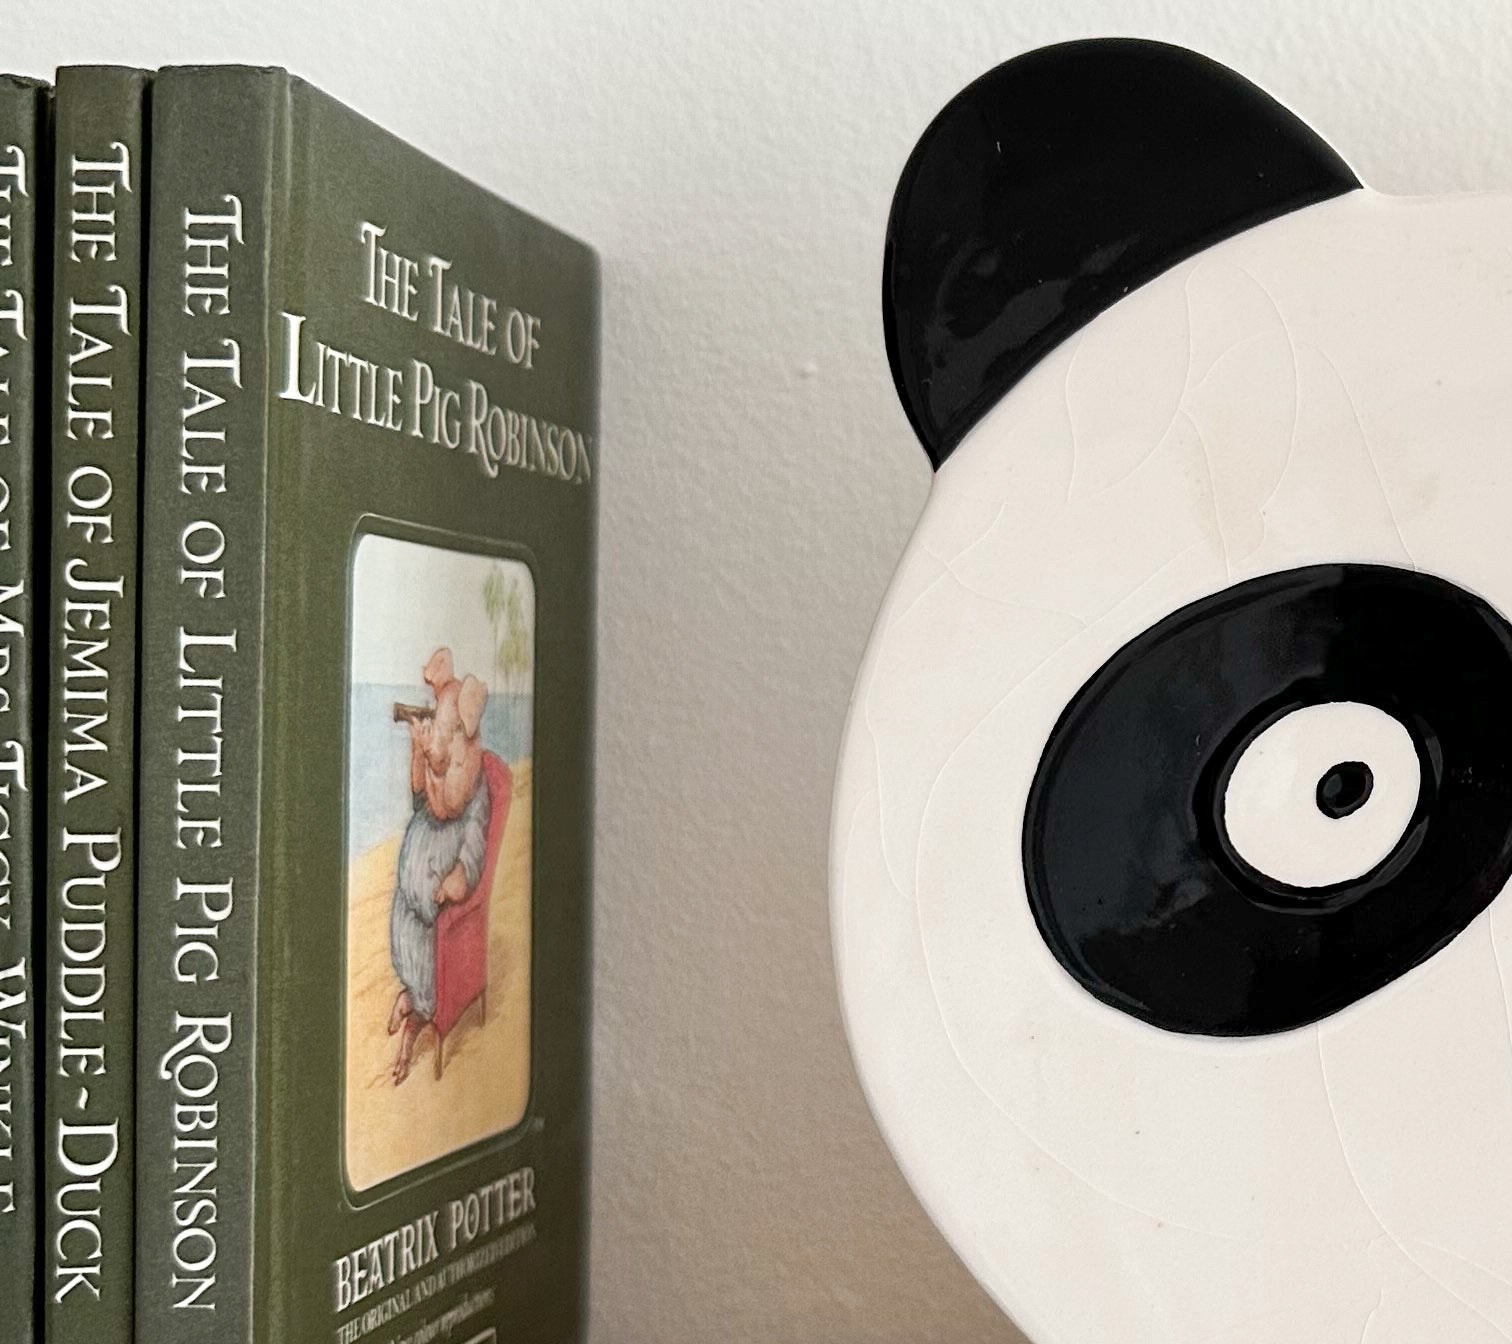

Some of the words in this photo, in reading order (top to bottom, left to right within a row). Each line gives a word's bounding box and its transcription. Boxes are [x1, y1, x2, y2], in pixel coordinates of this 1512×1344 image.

[72, 142, 132, 263] THE
[183, 193, 245, 317] THE
[66, 285, 132, 440] TALE
[359, 221, 418, 323] THE
[428, 256, 498, 356] TALE
[505, 309, 542, 370] OF
[180, 338, 243, 495] TALE
[279, 310, 404, 432] LITTLE
[411, 357, 461, 449] PIG
[467, 377, 594, 486] ROBINSON
[66, 465, 114, 544] OF
[180, 520, 226, 599] OF
[63, 558, 125, 805] JEMIMA
[176, 625, 238, 850] LITTLE
[173, 876, 234, 984] PIG
[158, 1010, 233, 1312] ROBINSON
[335, 1210, 440, 1313] BEATRIX
[448, 1166, 537, 1251] POTTER
[361, 1288, 413, 1335] ORIGINAL
[413, 1274, 437, 1306] AND
